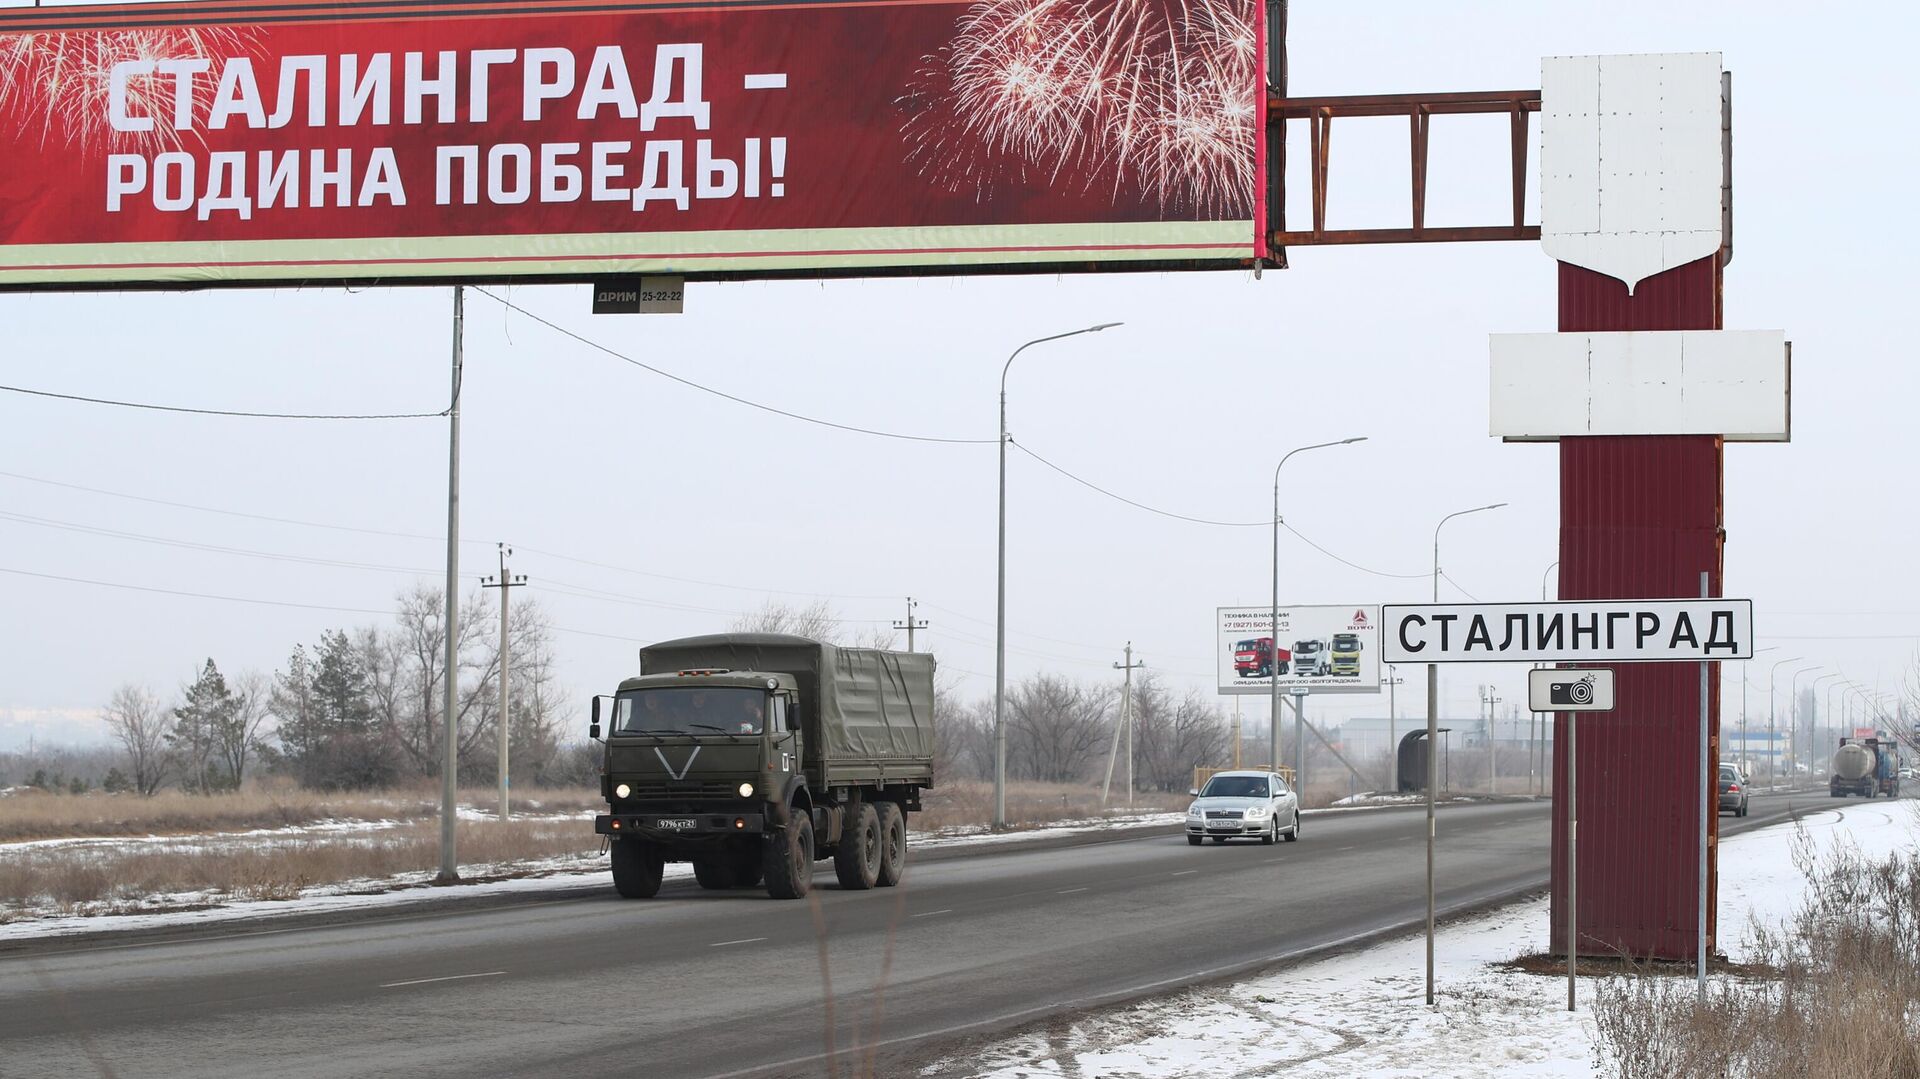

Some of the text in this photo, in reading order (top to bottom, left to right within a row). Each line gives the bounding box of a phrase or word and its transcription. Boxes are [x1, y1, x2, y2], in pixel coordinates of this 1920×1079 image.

[108, 42, 711, 132] СТАЛИНГРАД
[106, 137, 787, 222] РОДИНА ПОБЕДЫ!
[598, 291, 681, 302] ДРИМ 25-22-22
[1399, 611, 1738, 655] СТАЛИНГРАД
